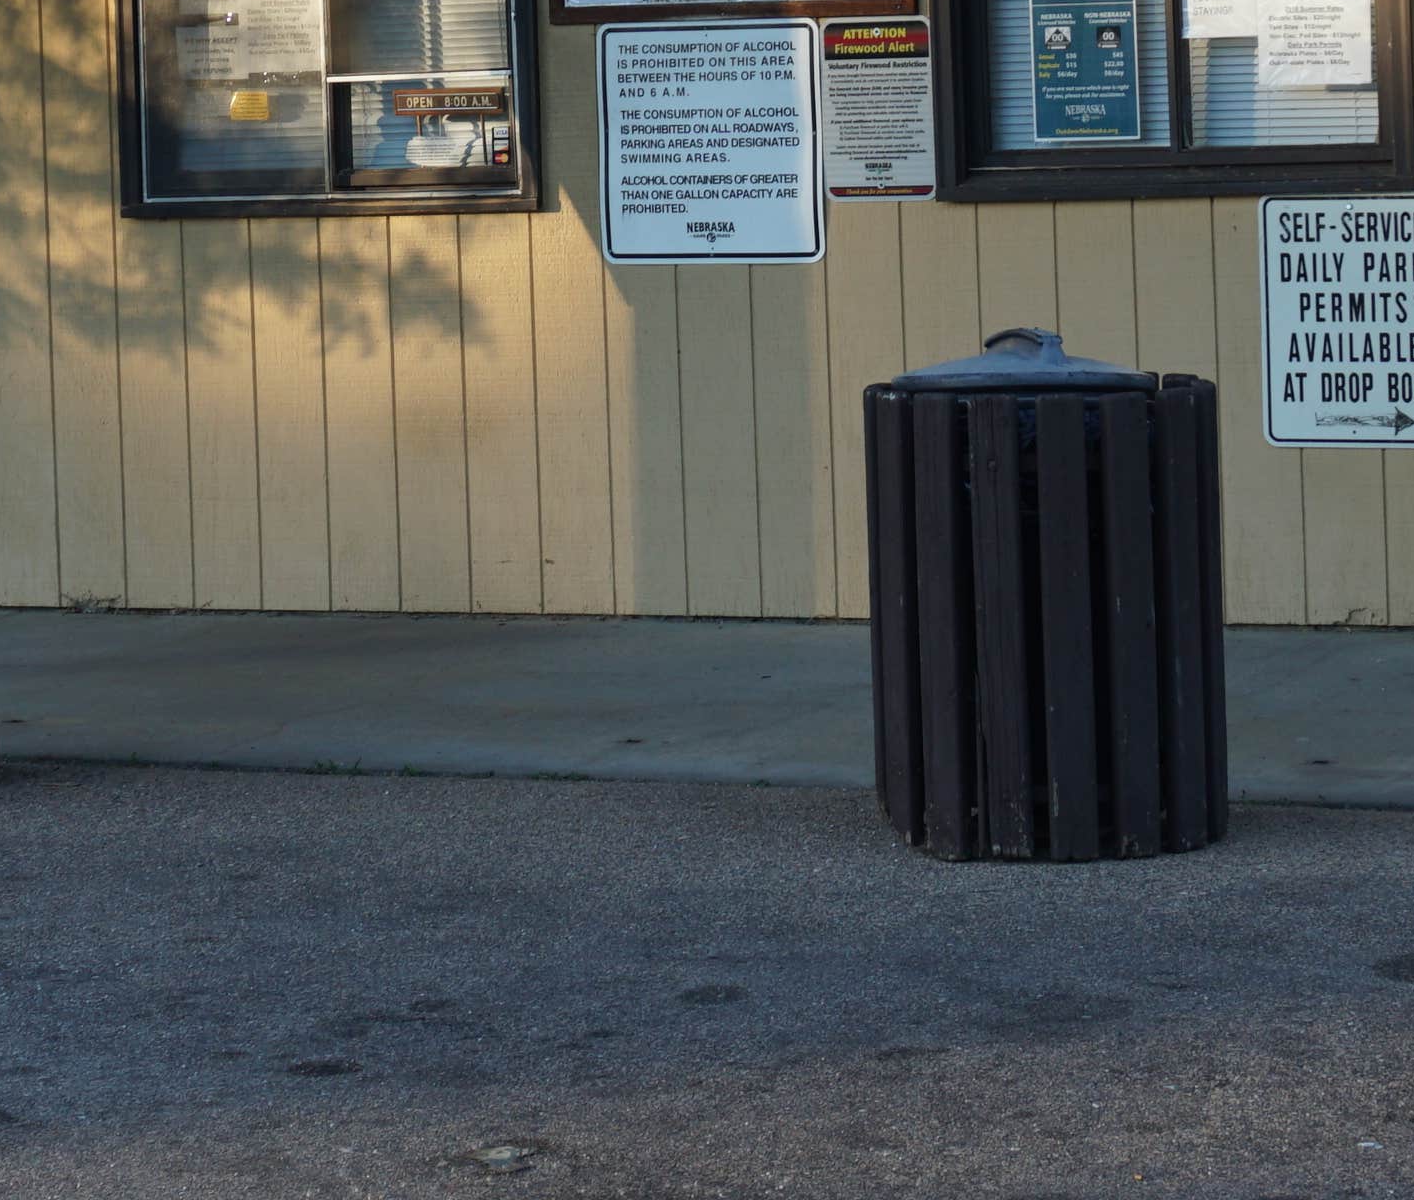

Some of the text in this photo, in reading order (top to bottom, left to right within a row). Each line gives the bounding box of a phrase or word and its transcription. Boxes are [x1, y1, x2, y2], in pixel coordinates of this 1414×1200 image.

[619, 42, 795, 54] THE CONSUMPTION OF ALCOHOL
[835, 42, 915, 53] Firewood Alert
[618, 56, 794, 69] IS PROHIBITED ON THIS AREA
[618, 71, 795, 83] BETWEEN THE HOURS OF 10 P.M.
[620, 88, 690, 98] AND 6 A.M.
[407, 97, 492, 109] OPEN 8:00 A.M.
[621, 108, 798, 120] THE CONSUMPTION OF ALCOHOL
[1066, 105, 1106, 117] NEBRASKA
[621, 123, 798, 135] IS PROHIBITED ON ALL ROADWAYS,
[621, 137, 800, 149] PARKING AREAS AND DESIGNATED
[621, 153, 730, 163] SWIMMING AREAS.
[622, 174, 798, 185] ALCOHOL CONTAINERS OF GREATER
[622, 189, 797, 200] THAN ONE GALLON CAPACITY ARE
[622, 204, 688, 213] PROHIBITED.
[687, 223, 734, 234] NEBRASKA
[1280, 253, 1343, 282] DAILY
[1300, 293, 1407, 322] PERMITS
[1284, 373, 1307, 402] AT
[1321, 373, 1373, 402] DROP
